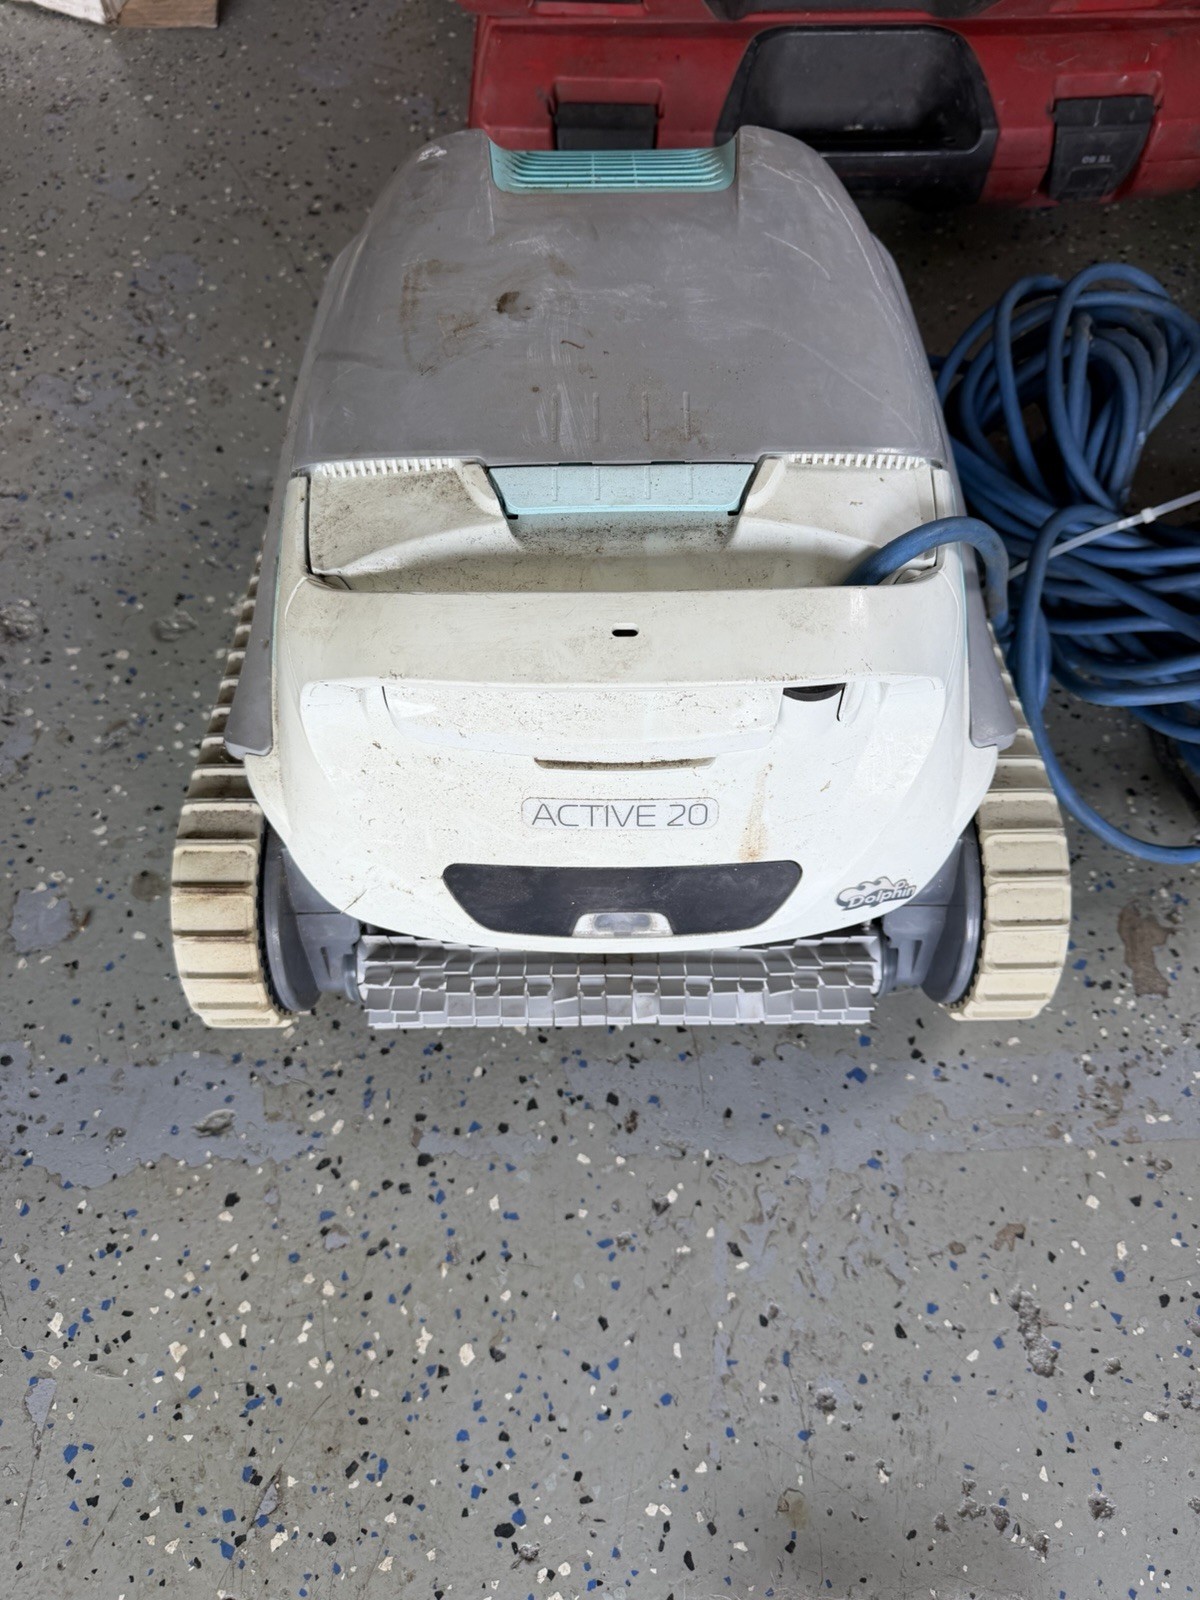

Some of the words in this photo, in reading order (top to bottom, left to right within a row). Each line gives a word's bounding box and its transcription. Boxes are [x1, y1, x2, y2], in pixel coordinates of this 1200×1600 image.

[532, 803, 656, 827] ACTIVE
[667, 803, 708, 826] 20
[845, 882, 916, 909] Dolphin
